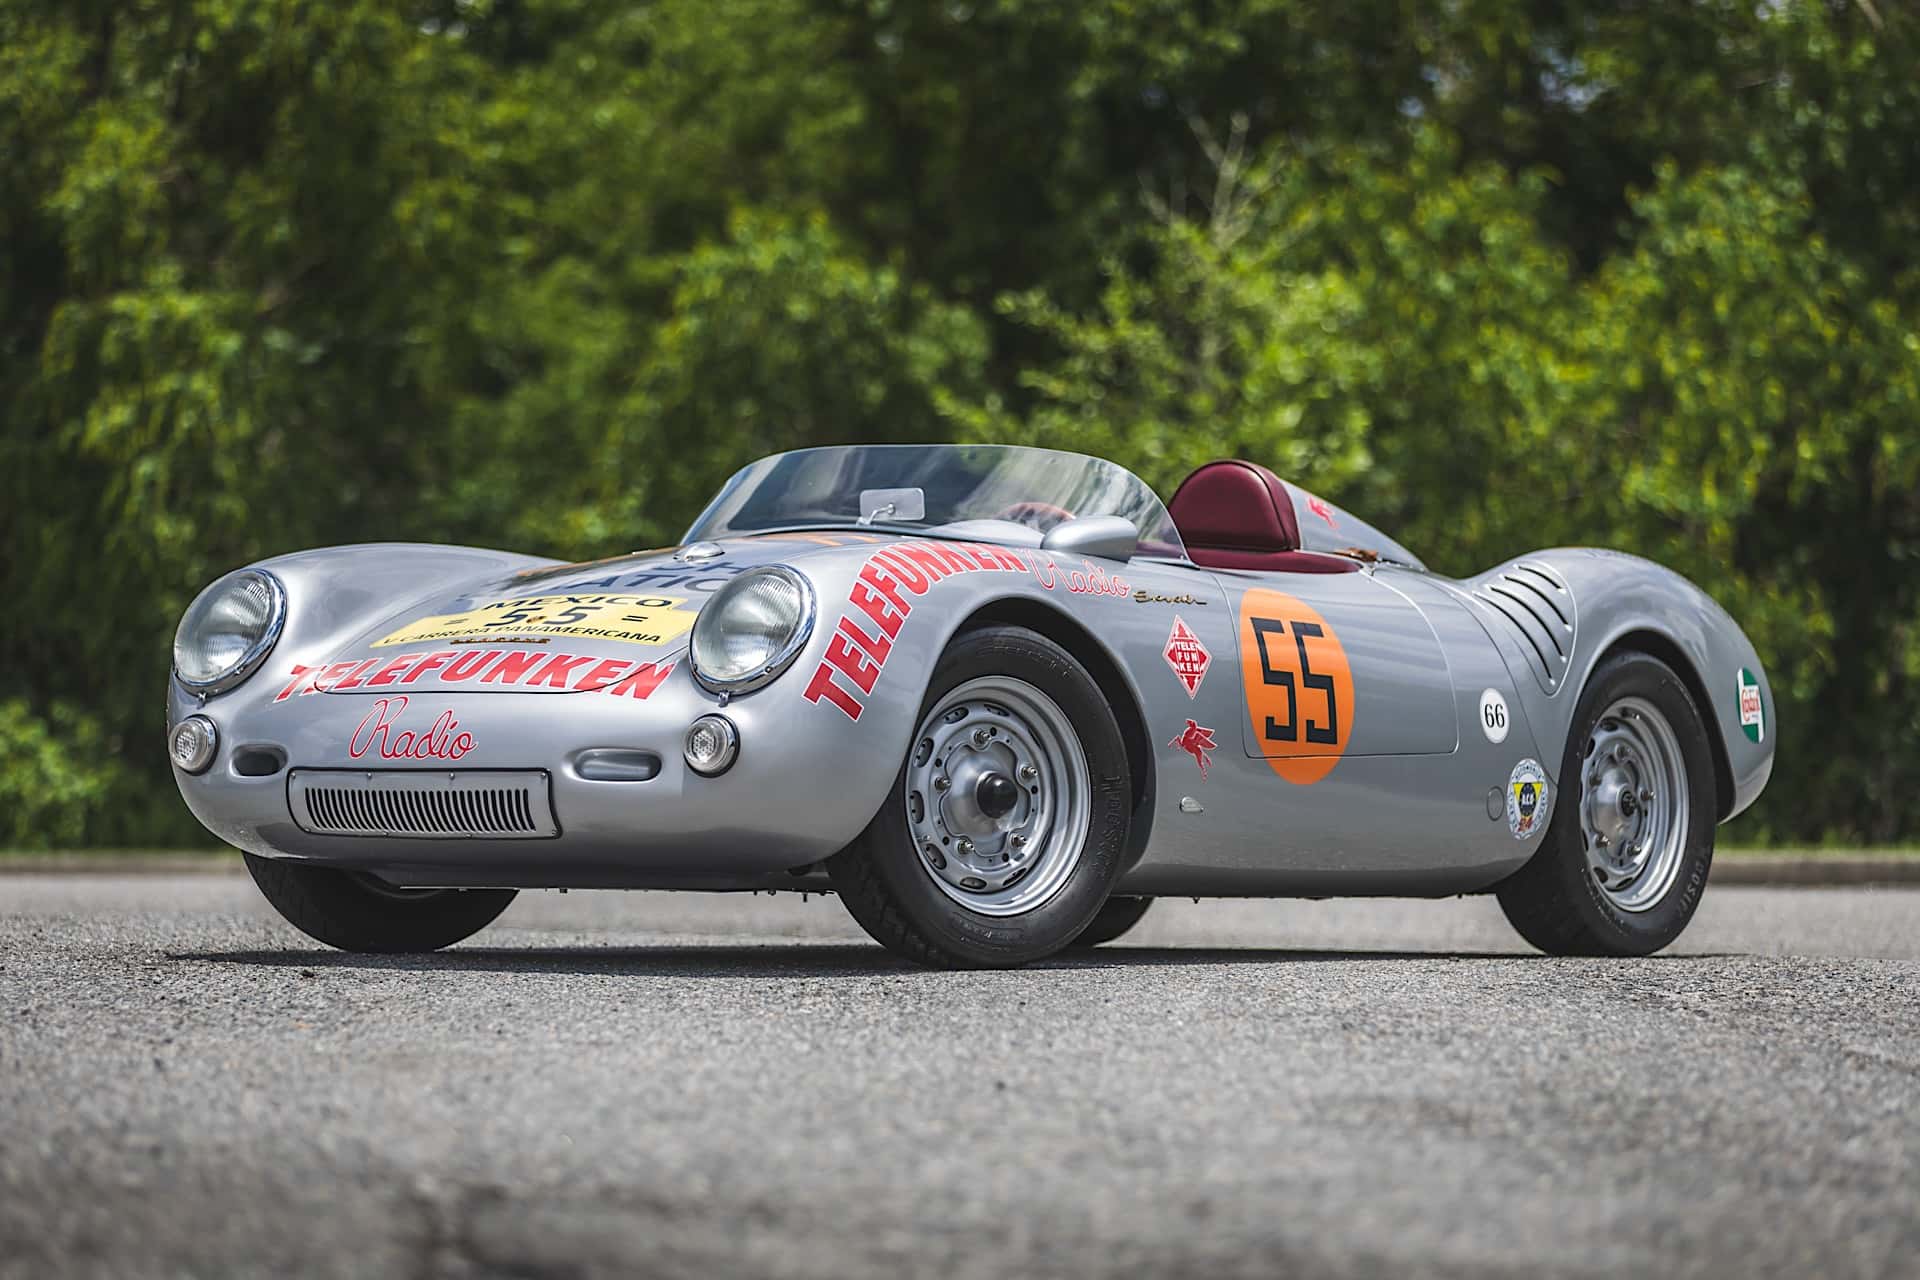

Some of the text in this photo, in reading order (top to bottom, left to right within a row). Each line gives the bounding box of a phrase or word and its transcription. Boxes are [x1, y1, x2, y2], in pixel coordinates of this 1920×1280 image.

[483, 596, 673, 610] MEXICO
[399, 627, 491, 643] CARRERA
[494, 625, 662, 643] PANAMERICANA
[802, 540, 1030, 722] TELEFUNKEN
[1024, 547, 1131, 598] Radio
[1175, 641, 1197, 651] TELE
[1177, 651, 1198, 662] FUN
[273, 650, 677, 702] TELEFUNKEN
[1179, 662, 1199, 672] KEN
[1250, 616, 1338, 745] 55
[1484, 702, 1506, 729] 66
[348, 695, 478, 761] Radio
